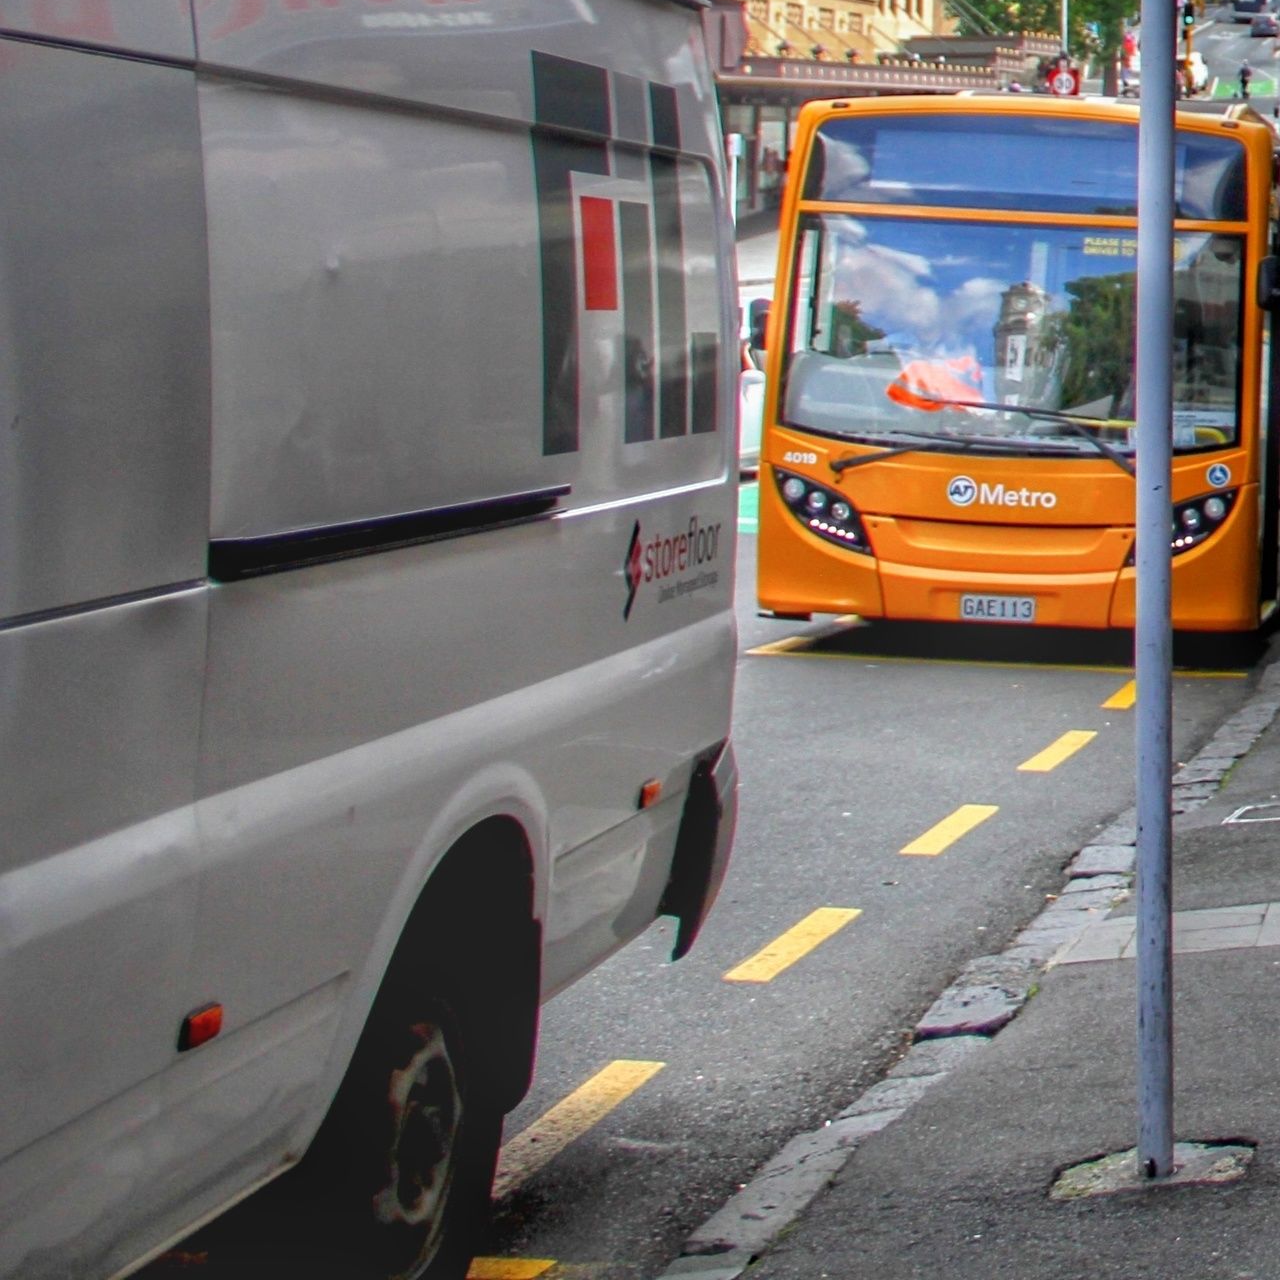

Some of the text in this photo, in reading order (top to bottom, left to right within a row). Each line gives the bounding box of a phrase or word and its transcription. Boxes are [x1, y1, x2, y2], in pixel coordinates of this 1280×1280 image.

[784, 451, 817, 464] 4019
[979, 483, 1057, 508] Metro
[963, 598, 1033, 618] GAE113
